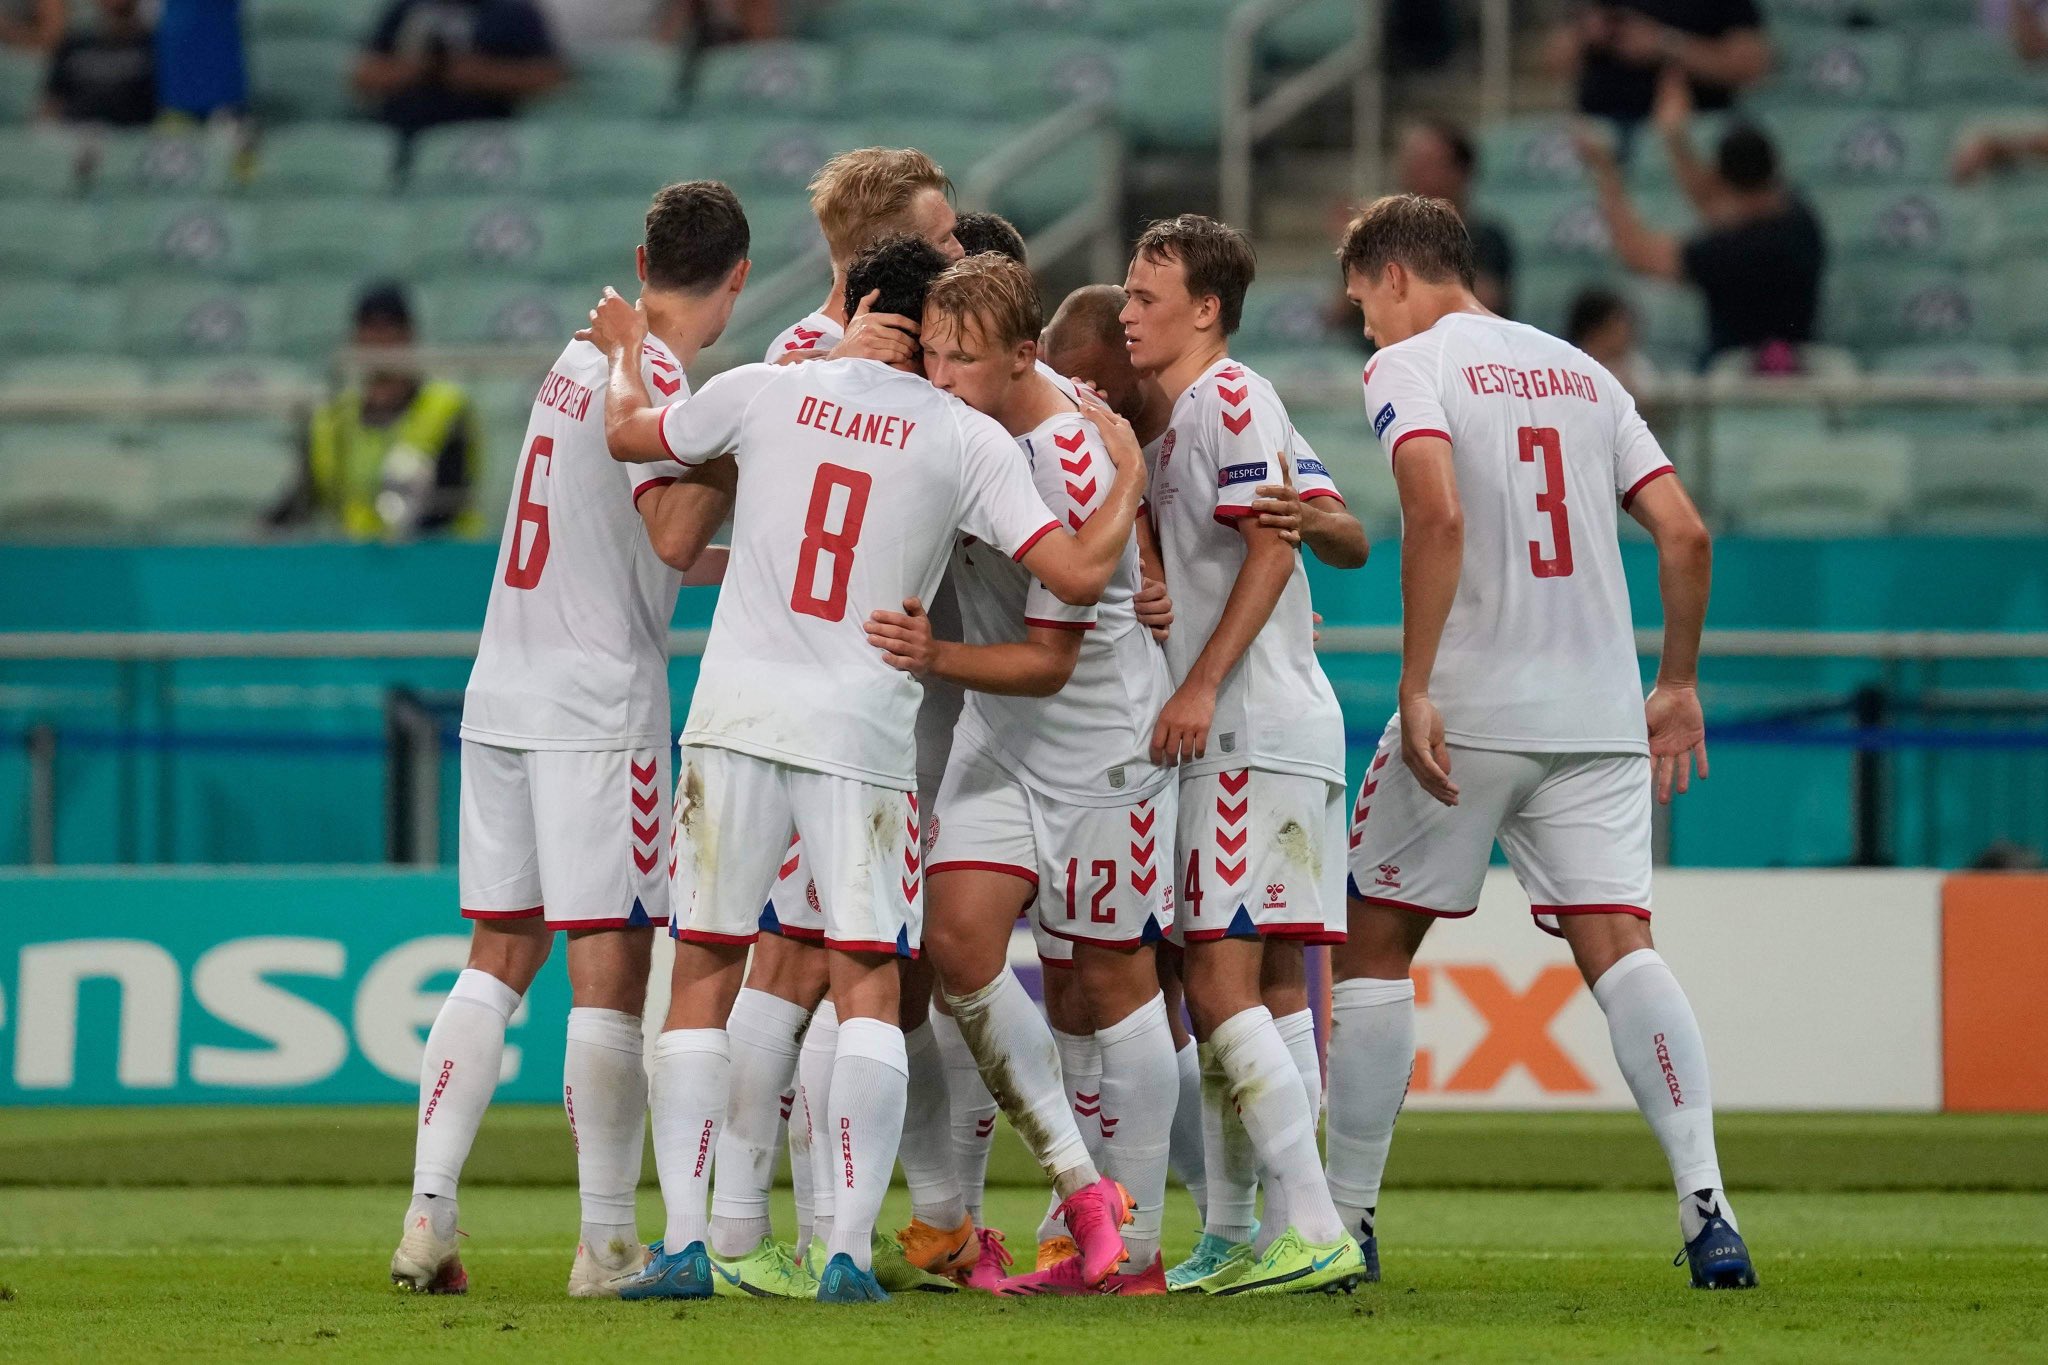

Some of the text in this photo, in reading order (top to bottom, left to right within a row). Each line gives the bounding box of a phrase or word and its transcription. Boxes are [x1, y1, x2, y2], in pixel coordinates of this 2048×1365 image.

[1461, 363, 1598, 403] VESTERGAARD
[796, 395, 916, 451] DELANEY
[1229, 467, 1266, 480] RESPECT
[1516, 426, 1574, 578] 3
[504, 434, 554, 590] 6
[790, 461, 873, 623] 8
[1065, 856, 1118, 924] 12
[1262, 901, 1287, 910] hummel
[0, 934, 530, 1090] nse
[424, 1059, 454, 1125] DANMARK
[1653, 1032, 1685, 1107] DANMARK
[694, 1119, 713, 1178] DANMARK
[841, 1117, 855, 1189] DANMARK
[1708, 1246, 1738, 1258] COPA
